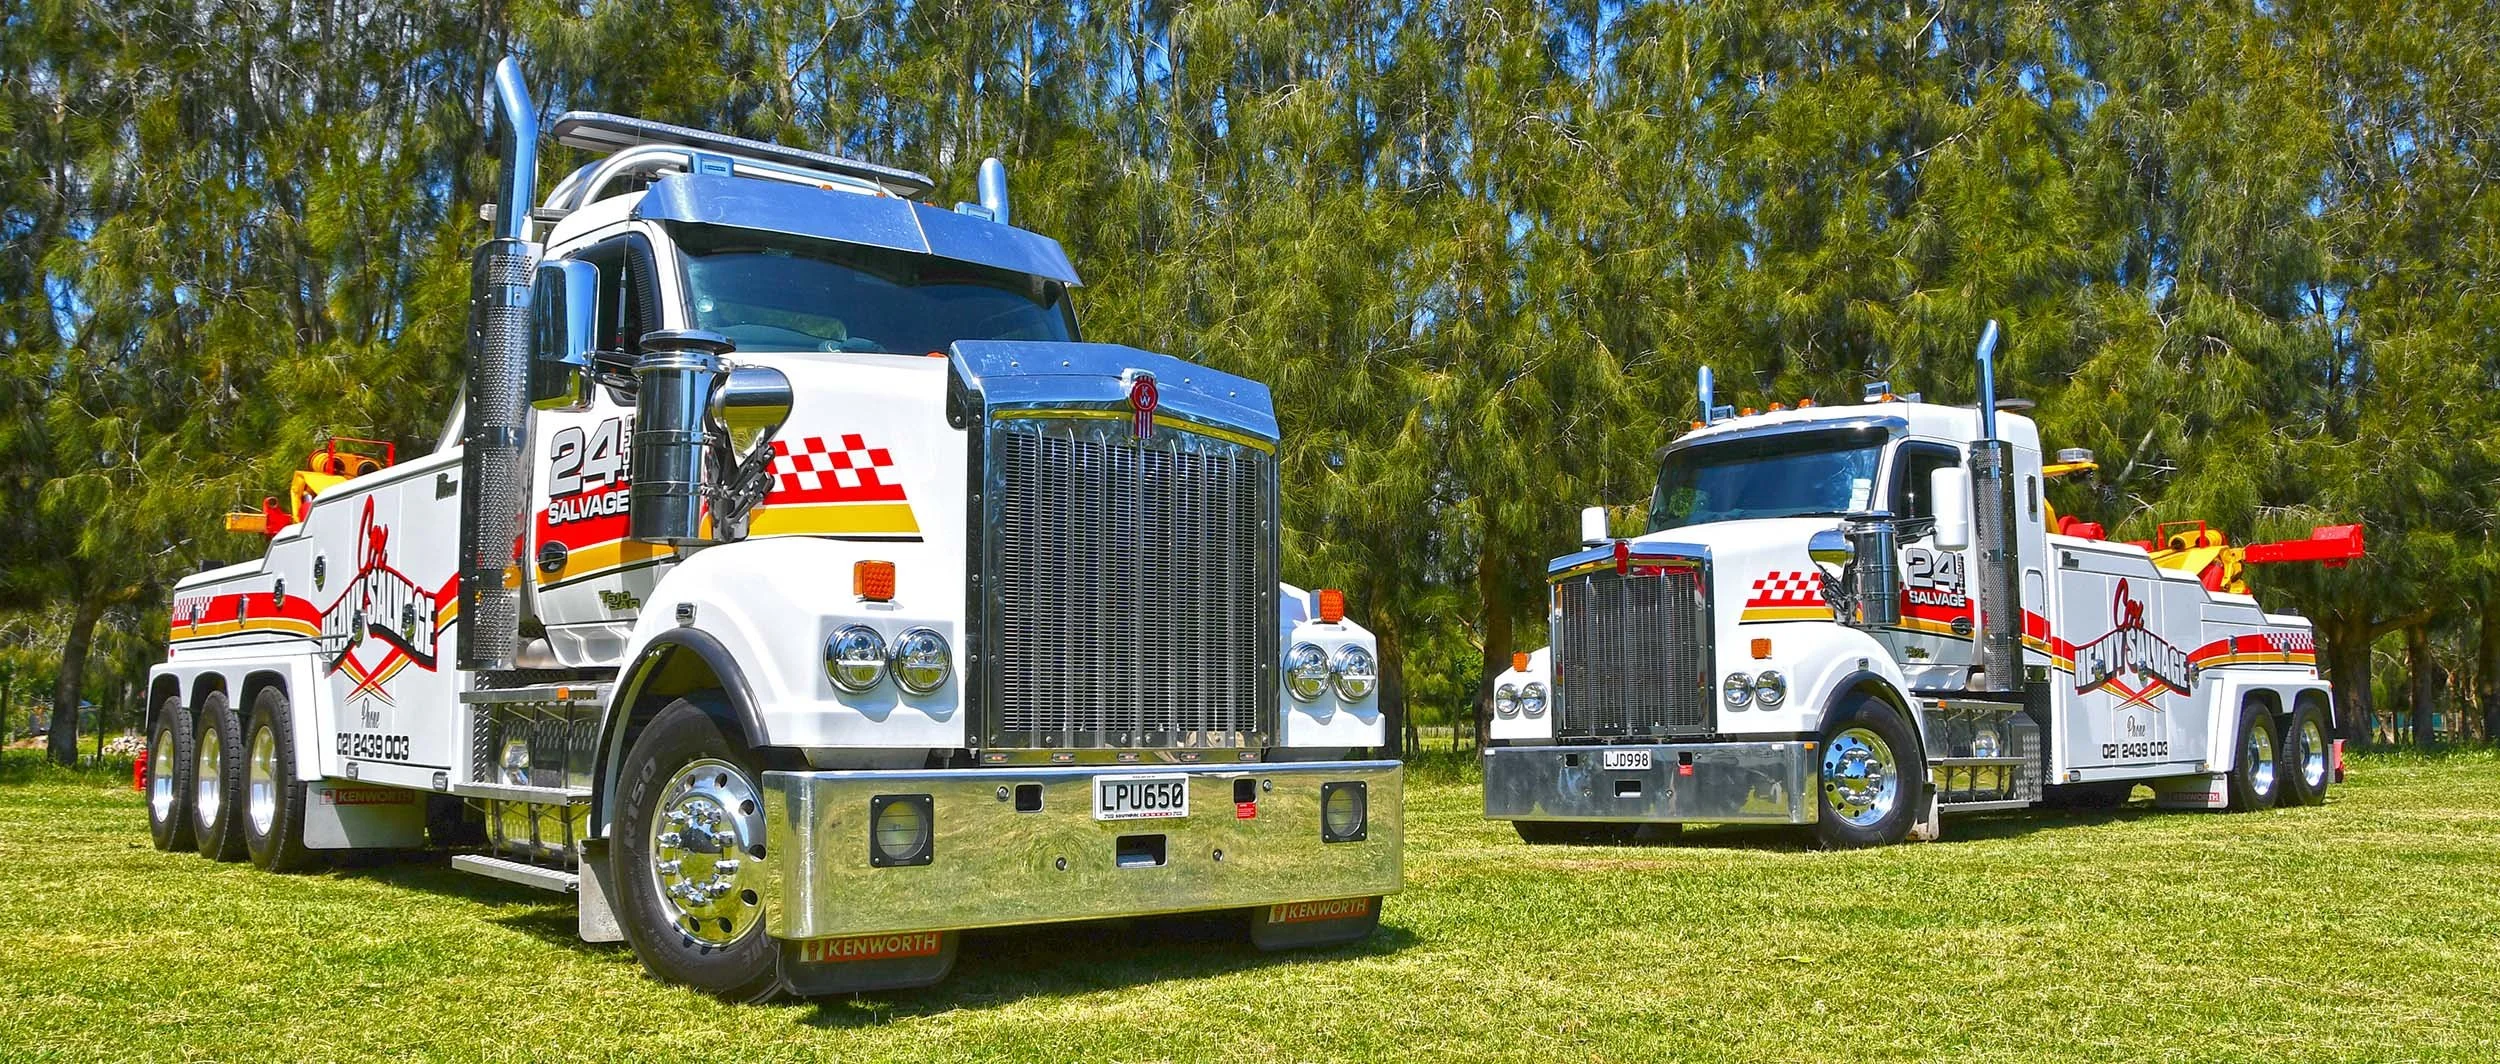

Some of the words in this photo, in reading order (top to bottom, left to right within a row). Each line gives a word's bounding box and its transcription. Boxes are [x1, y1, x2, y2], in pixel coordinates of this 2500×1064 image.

[550, 417, 622, 498] 24
[548, 489, 630, 525] SALVAGE
[1906, 548, 1959, 592] 24
[1909, 591, 1966, 608] SALVAGE
[2126, 627, 2188, 689] SALVAGE
[337, 732, 351, 756] 021
[354, 733, 383, 758] 2439
[385, 735, 409, 760] 003
[2103, 743, 2119, 759] 021
[2122, 743, 2148, 758] 2439
[2150, 741, 2168, 756] 003
[1605, 753, 1649, 767] LJD998
[338, 789, 414, 803] KENWORTH
[1102, 783, 1184, 811] LPU650
[1288, 899, 1367, 919] KENWORTH
[828, 933, 937, 957] KENWORTH
